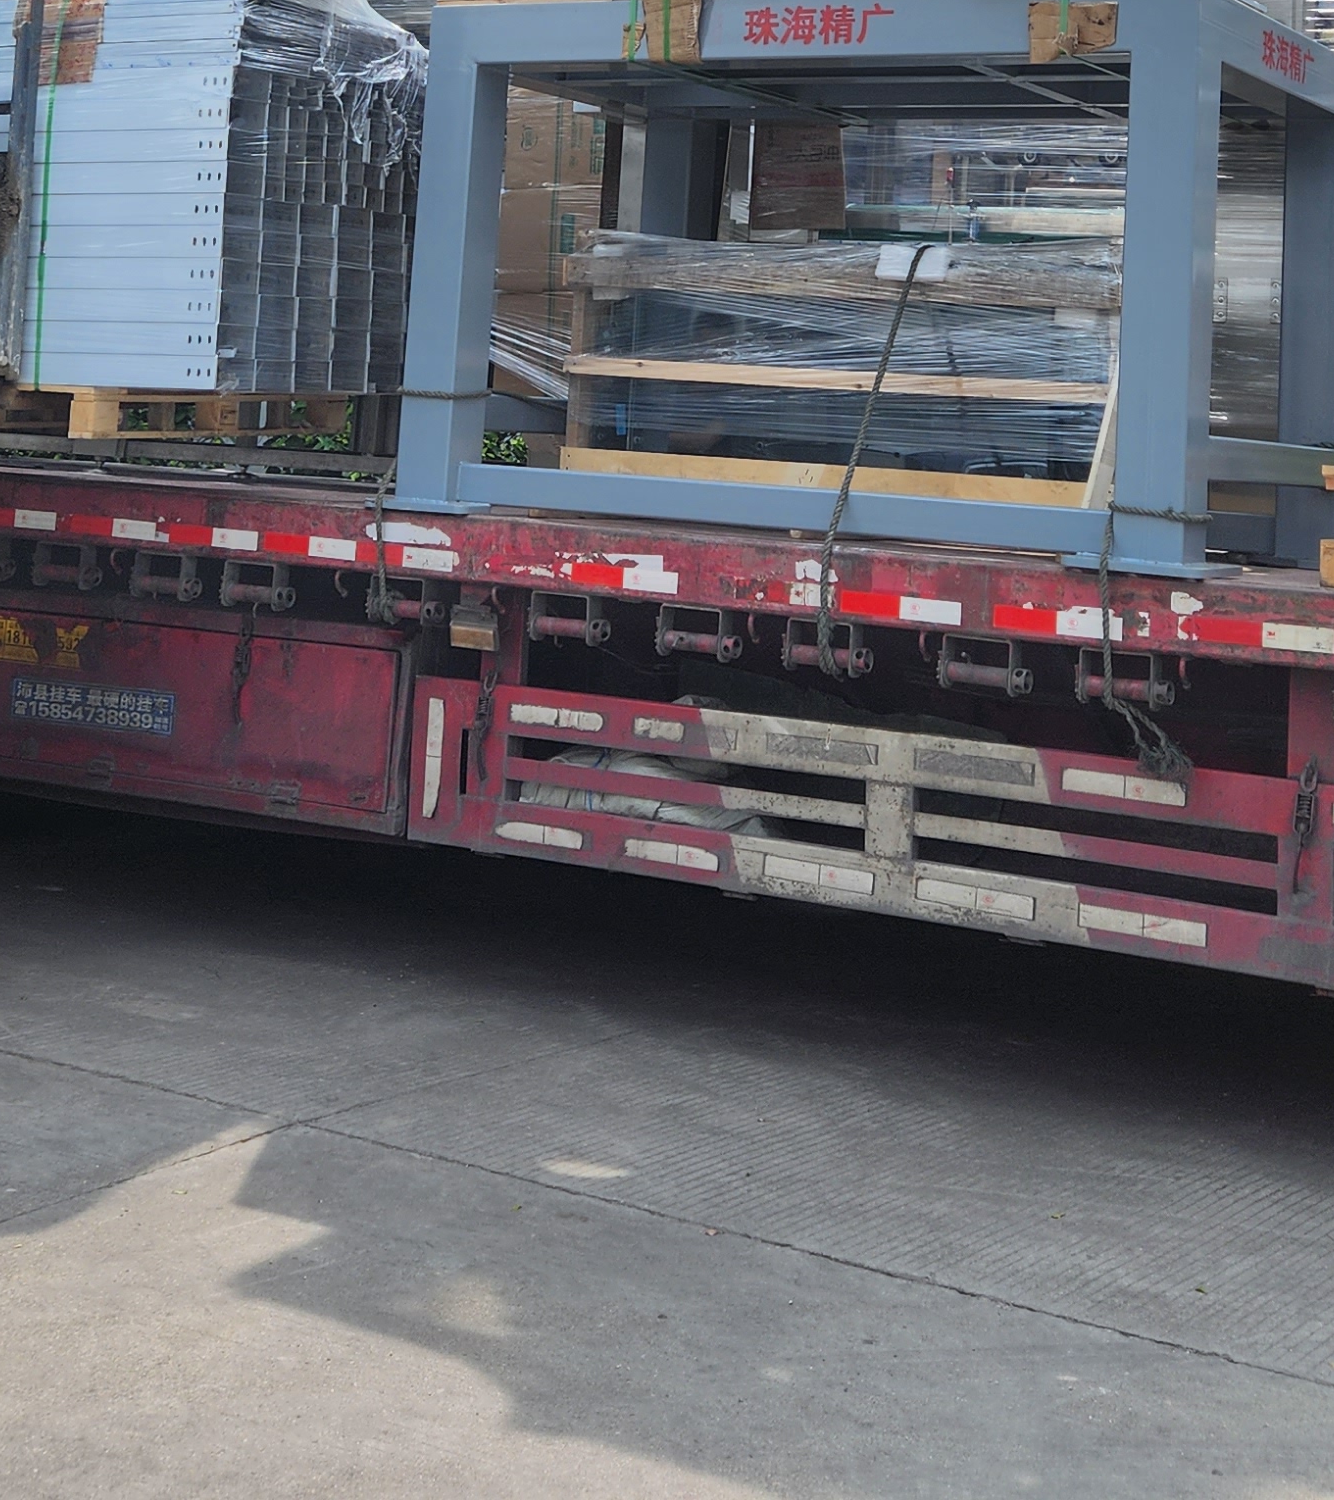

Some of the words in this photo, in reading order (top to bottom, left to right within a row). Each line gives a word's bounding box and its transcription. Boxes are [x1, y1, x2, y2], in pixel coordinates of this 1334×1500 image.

[743, 2, 894, 46] 珠海精广
[1262, 29, 1315, 84] 珠海精广
[28, 700, 154, 730] 15854738939
